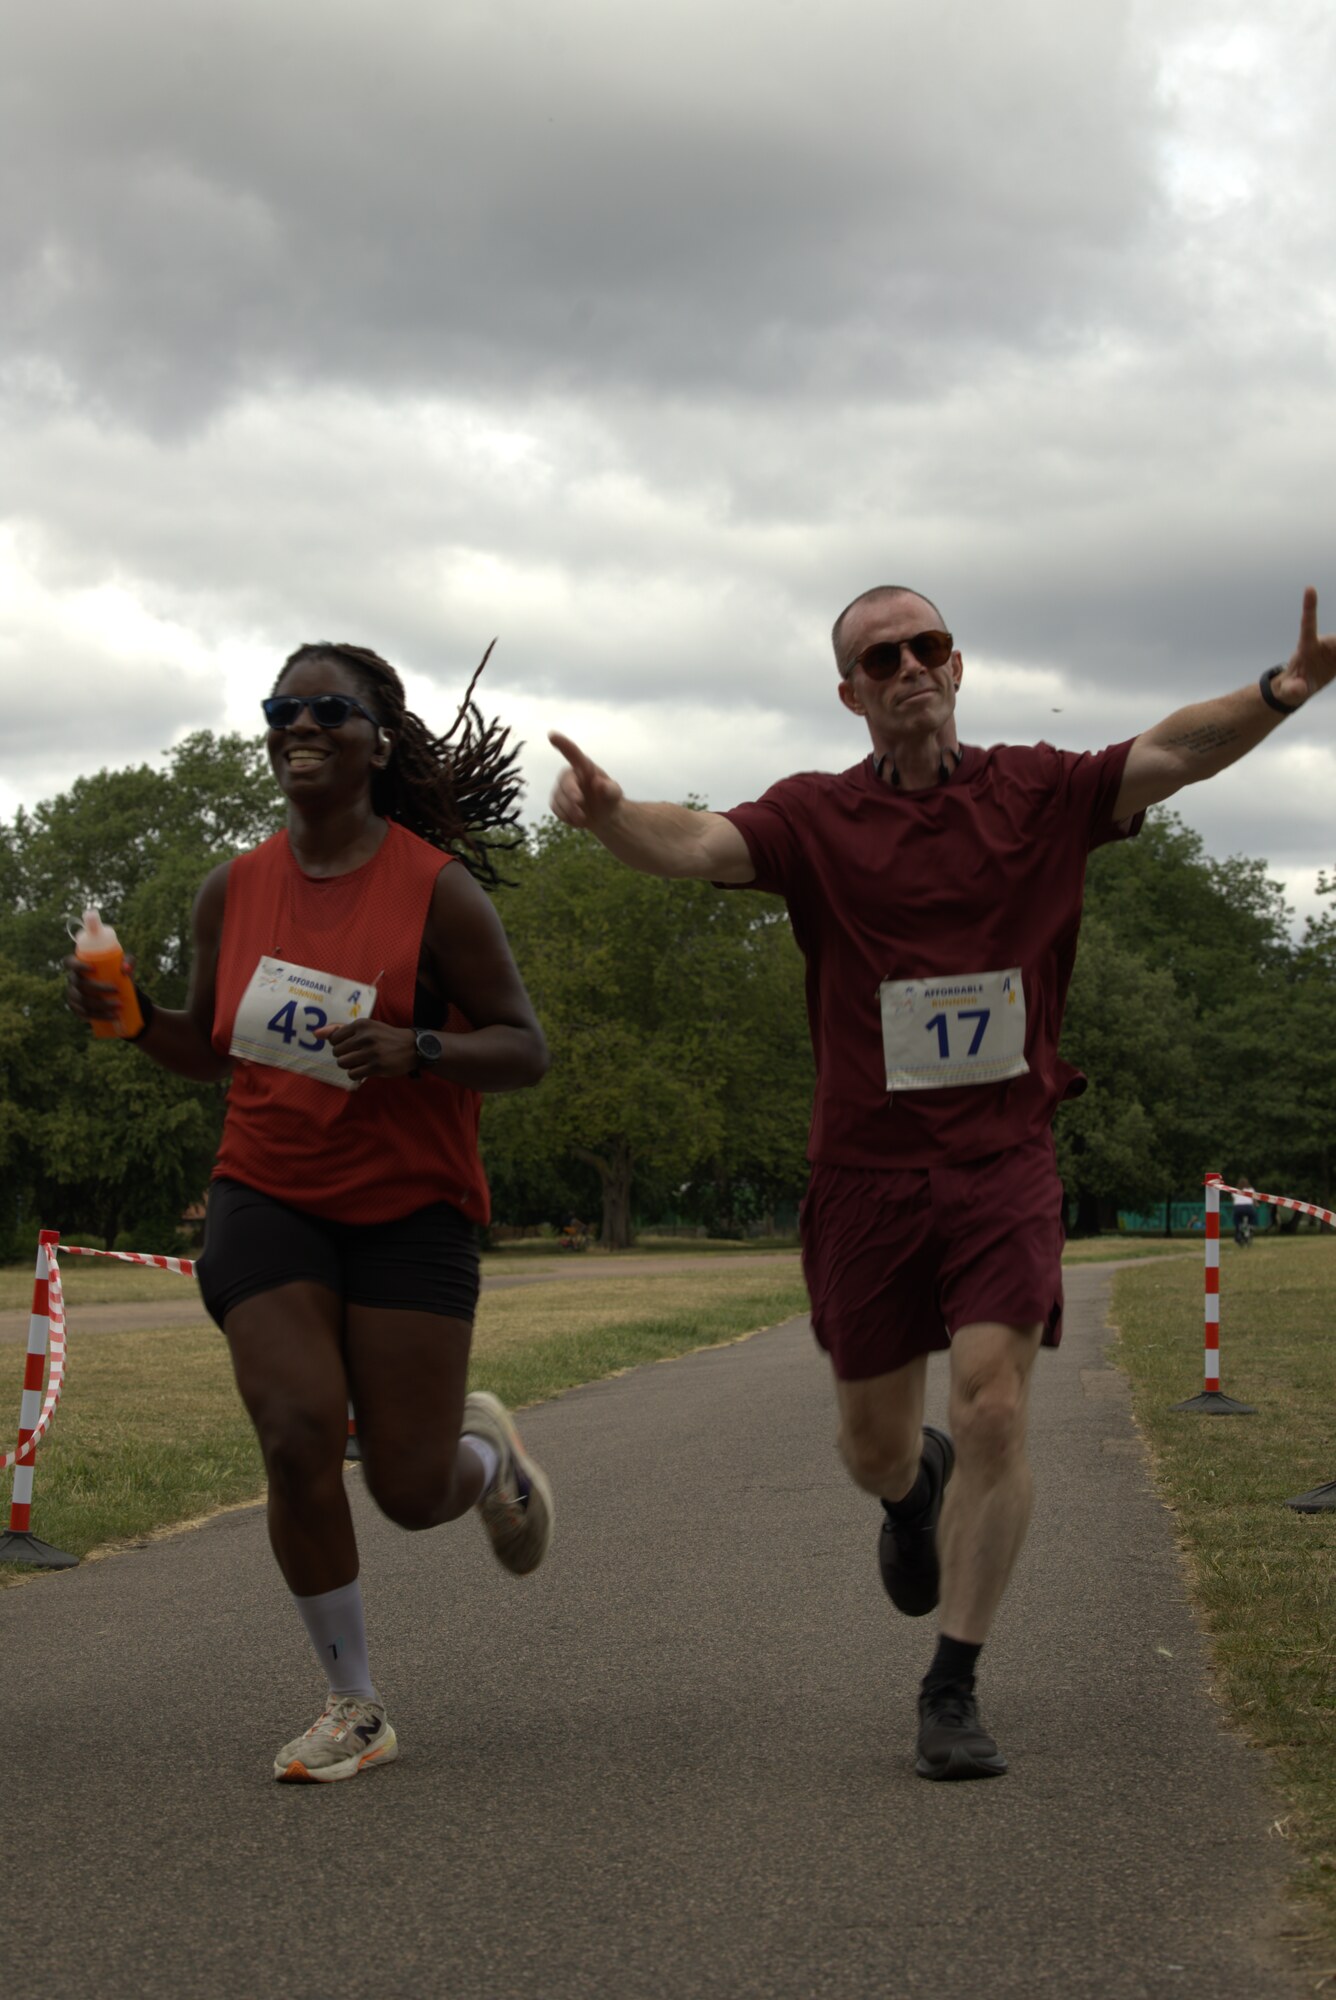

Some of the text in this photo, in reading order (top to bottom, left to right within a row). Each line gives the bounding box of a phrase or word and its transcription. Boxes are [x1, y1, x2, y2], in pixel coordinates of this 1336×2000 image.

[287, 975, 333, 994] AFFORDABLE
[288, 985, 324, 1003] RUNNING
[924, 984, 983, 998] AFFORDABLE
[267, 1000, 328, 1052] 43
[925, 1007, 991, 1059] 17
